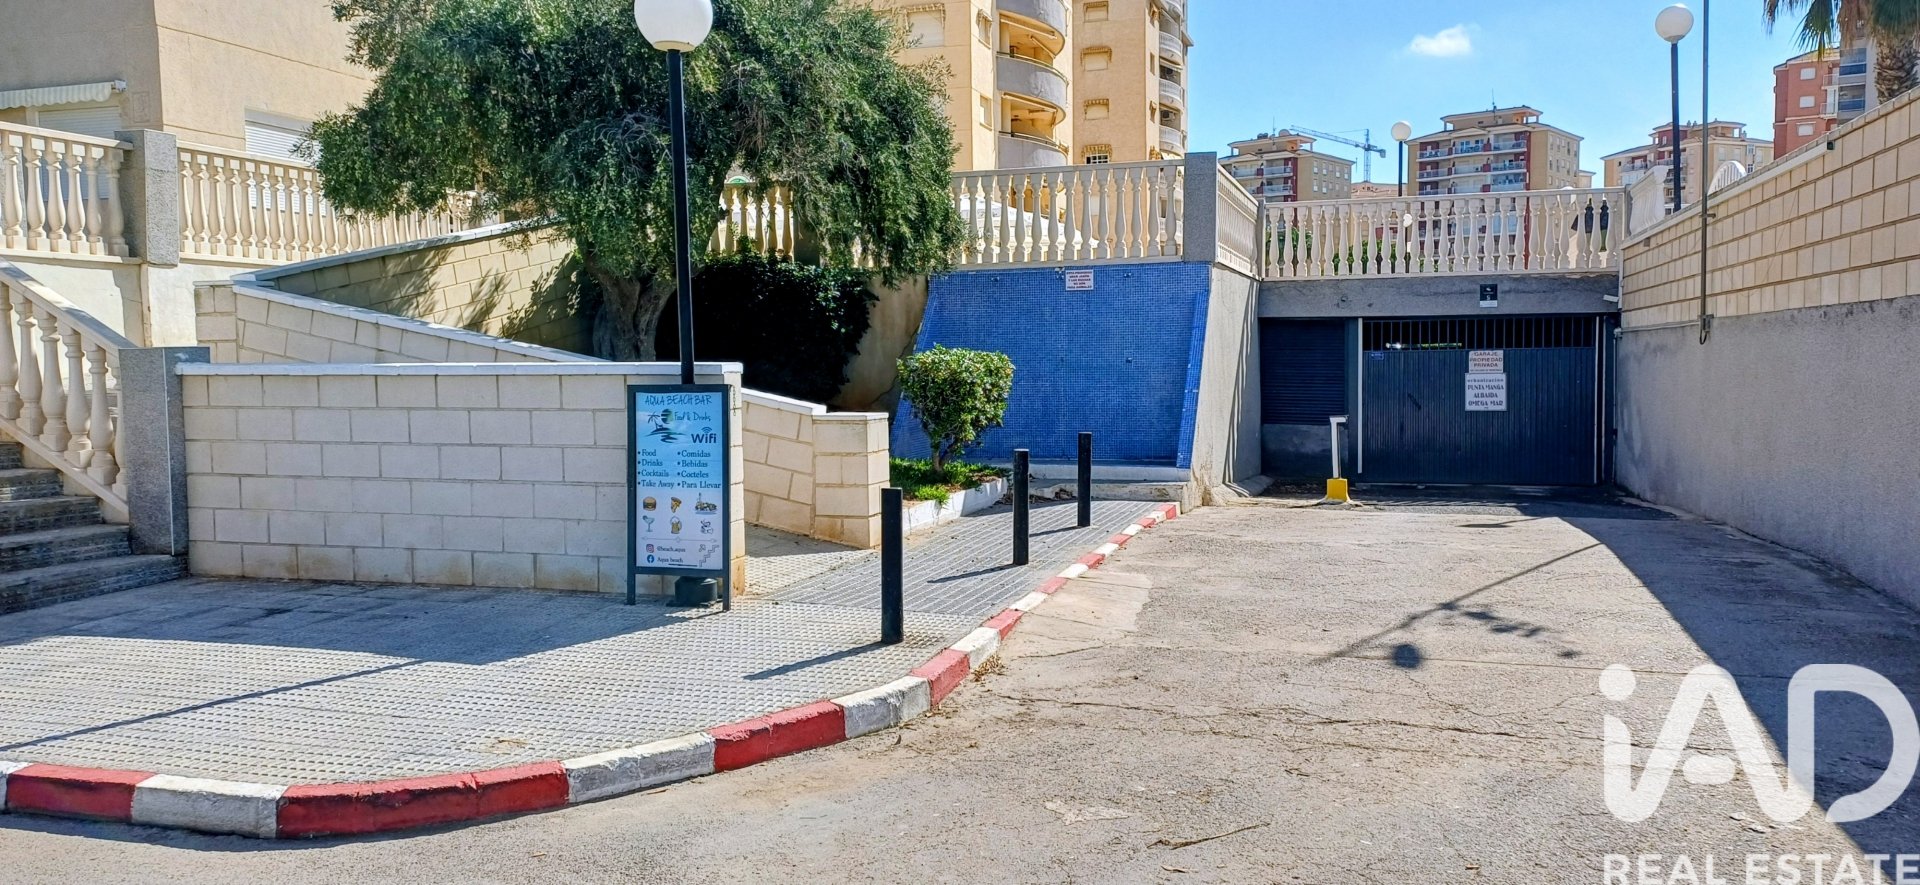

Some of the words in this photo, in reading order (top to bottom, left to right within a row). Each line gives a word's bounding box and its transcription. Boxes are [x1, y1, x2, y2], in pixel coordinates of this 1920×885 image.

[645, 394, 665, 406] AQUA
[666, 394, 693, 405] BEACH
[694, 394, 712, 405] BAR
[692, 411, 711, 422] Drinks
[691, 433, 717, 443] Wifi
[641, 449, 657, 457] Food
[681, 449, 711, 458] Comidas
[641, 459, 663, 467] Drinks
[641, 469, 670, 477] Cocktails
[681, 470, 709, 478] Cocteles
[658, 480, 675, 489] Away
[681, 481, 698, 489] Para
[699, 481, 721, 489] Llevar
